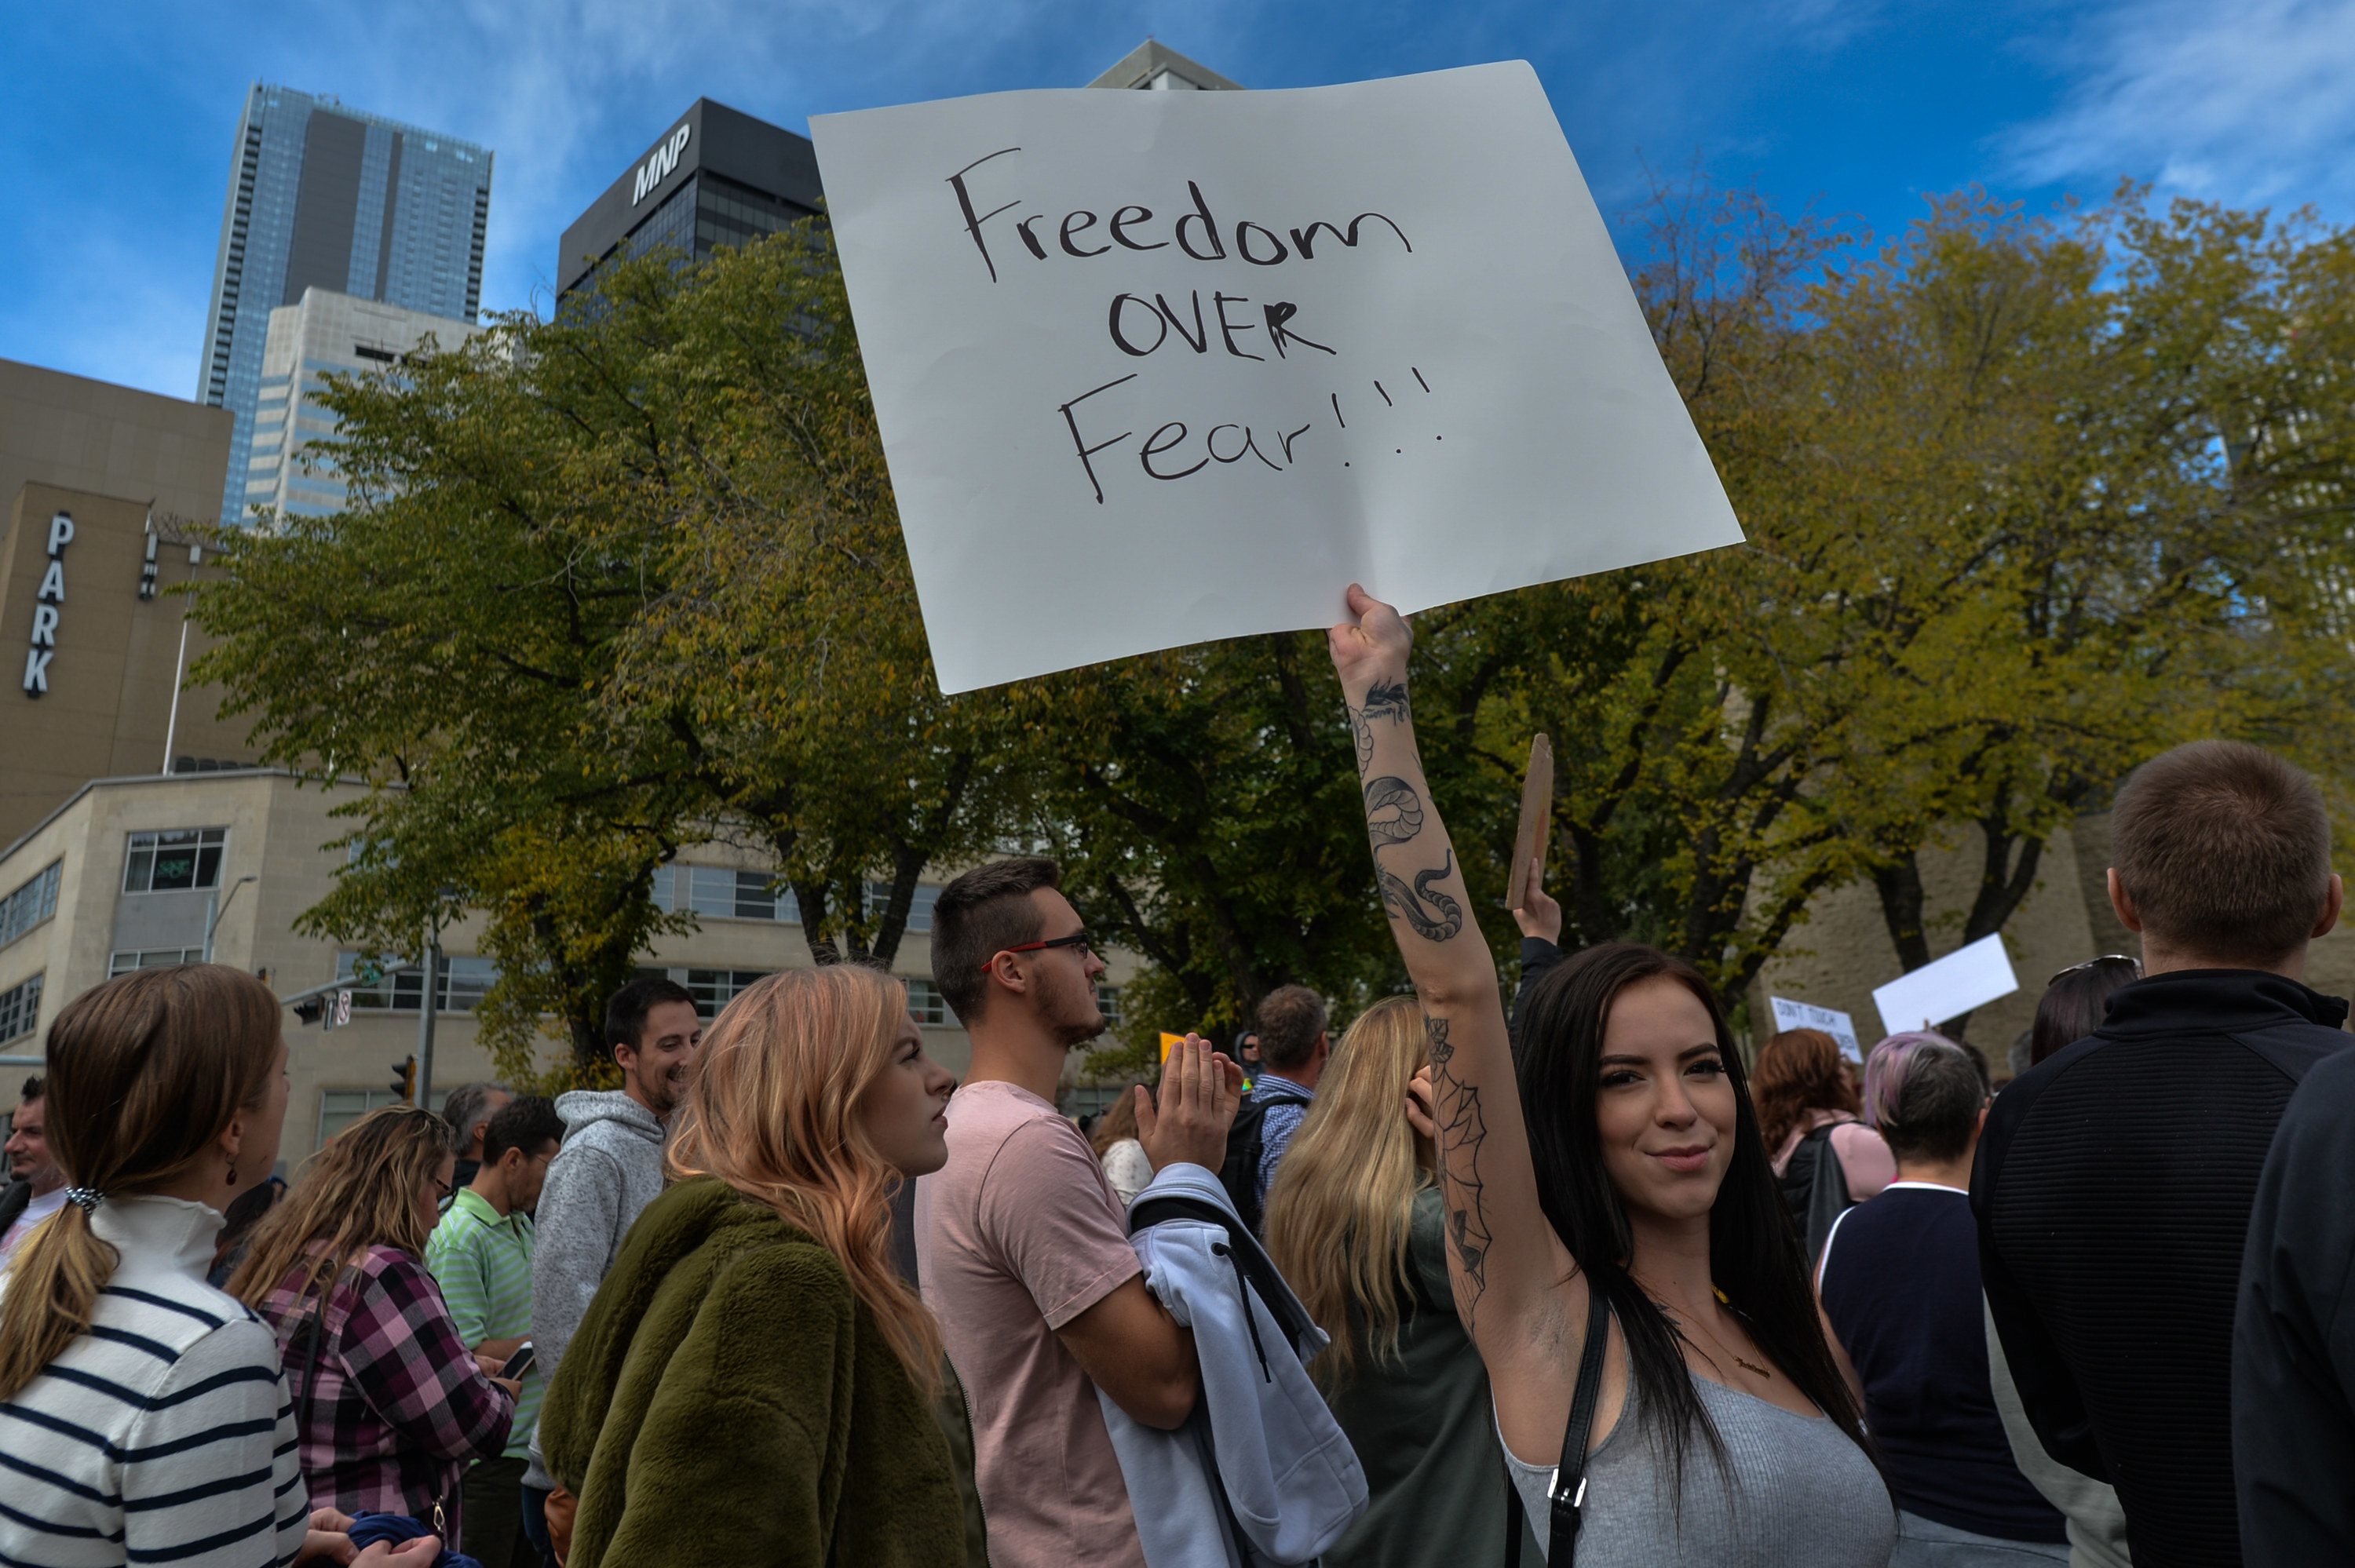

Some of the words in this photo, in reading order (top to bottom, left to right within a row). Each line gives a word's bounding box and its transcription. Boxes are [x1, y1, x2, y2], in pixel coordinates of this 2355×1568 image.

[633, 123, 692, 207] MNP
[944, 147, 1413, 283] Freedom
[1108, 289, 1338, 361] OVER
[1057, 366, 1443, 505] Fear!!!
[23, 515, 75, 692] PARK
